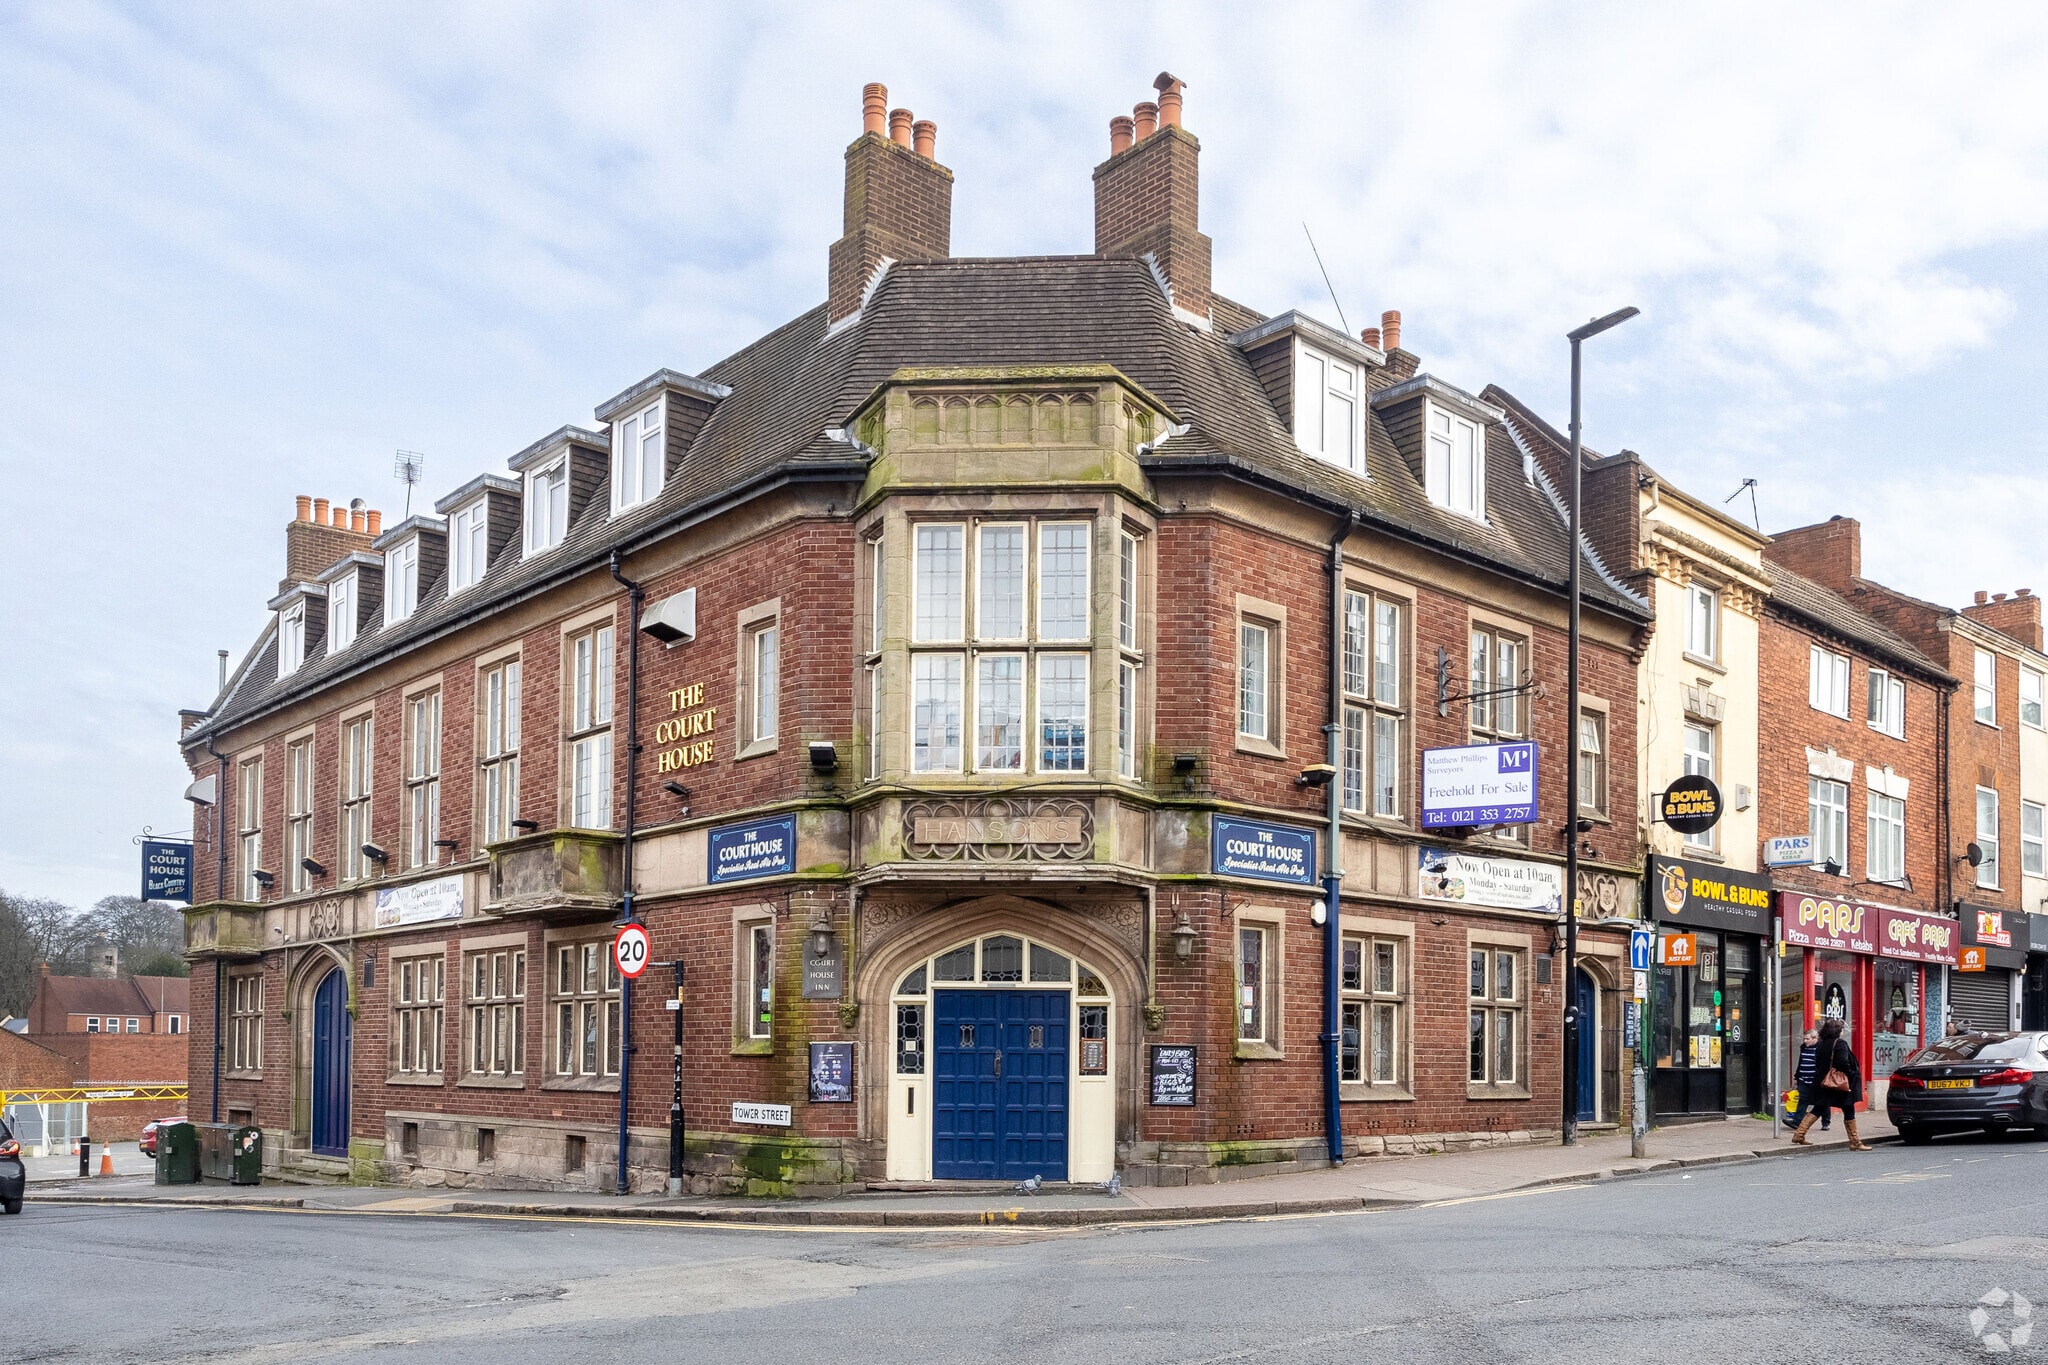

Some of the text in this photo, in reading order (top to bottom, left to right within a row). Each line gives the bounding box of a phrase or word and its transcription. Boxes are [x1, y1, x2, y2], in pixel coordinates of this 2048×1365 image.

[668, 682, 704, 712] THE
[656, 707, 717, 744] COURT
[658, 740, 713, 773] HOUSE
[1428, 755, 1488, 765] Matthew Phillips
[1427, 767, 1464, 775] Surveyors
[1429, 781, 1528, 797] Freehold For Sale
[1670, 790, 1712, 803] BOWL
[1427, 807, 1530, 823] Tel: 0121 353 2757
[1665, 801, 1715, 815] & BUNS
[744, 831, 757, 842] THE
[925, 821, 1069, 841] HANSONS
[1258, 831, 1273, 843] THE
[720, 838, 783, 862] COURT HOUSE
[1226, 839, 1303, 862] COURT HOUSE
[1775, 838, 1809, 850] PARS
[150, 855, 186, 865] COURT
[150, 866, 185, 875] HOUSE
[1456, 857, 1479, 873] Now
[1483, 861, 1510, 878] Open
[1514, 869, 1523, 879] at
[1527, 868, 1553, 882] 10am
[1469, 877, 1497, 891] Monday
[1504, 883, 1532, 893] Saturday
[1692, 878, 1769, 908] BOWL & BUNS
[411, 887, 428, 901] Open
[1704, 904, 1757, 917] HEALTHY CASUAL FOOD
[1799, 898, 1864, 938] PARS
[1789, 928, 1809, 943] Pizza
[1851, 938, 1873, 952] Kebabs
[1922, 924, 1950, 951] PARS
[620, 940, 644, 962] 20
[734, 1107, 789, 1121] TOWER STREET
